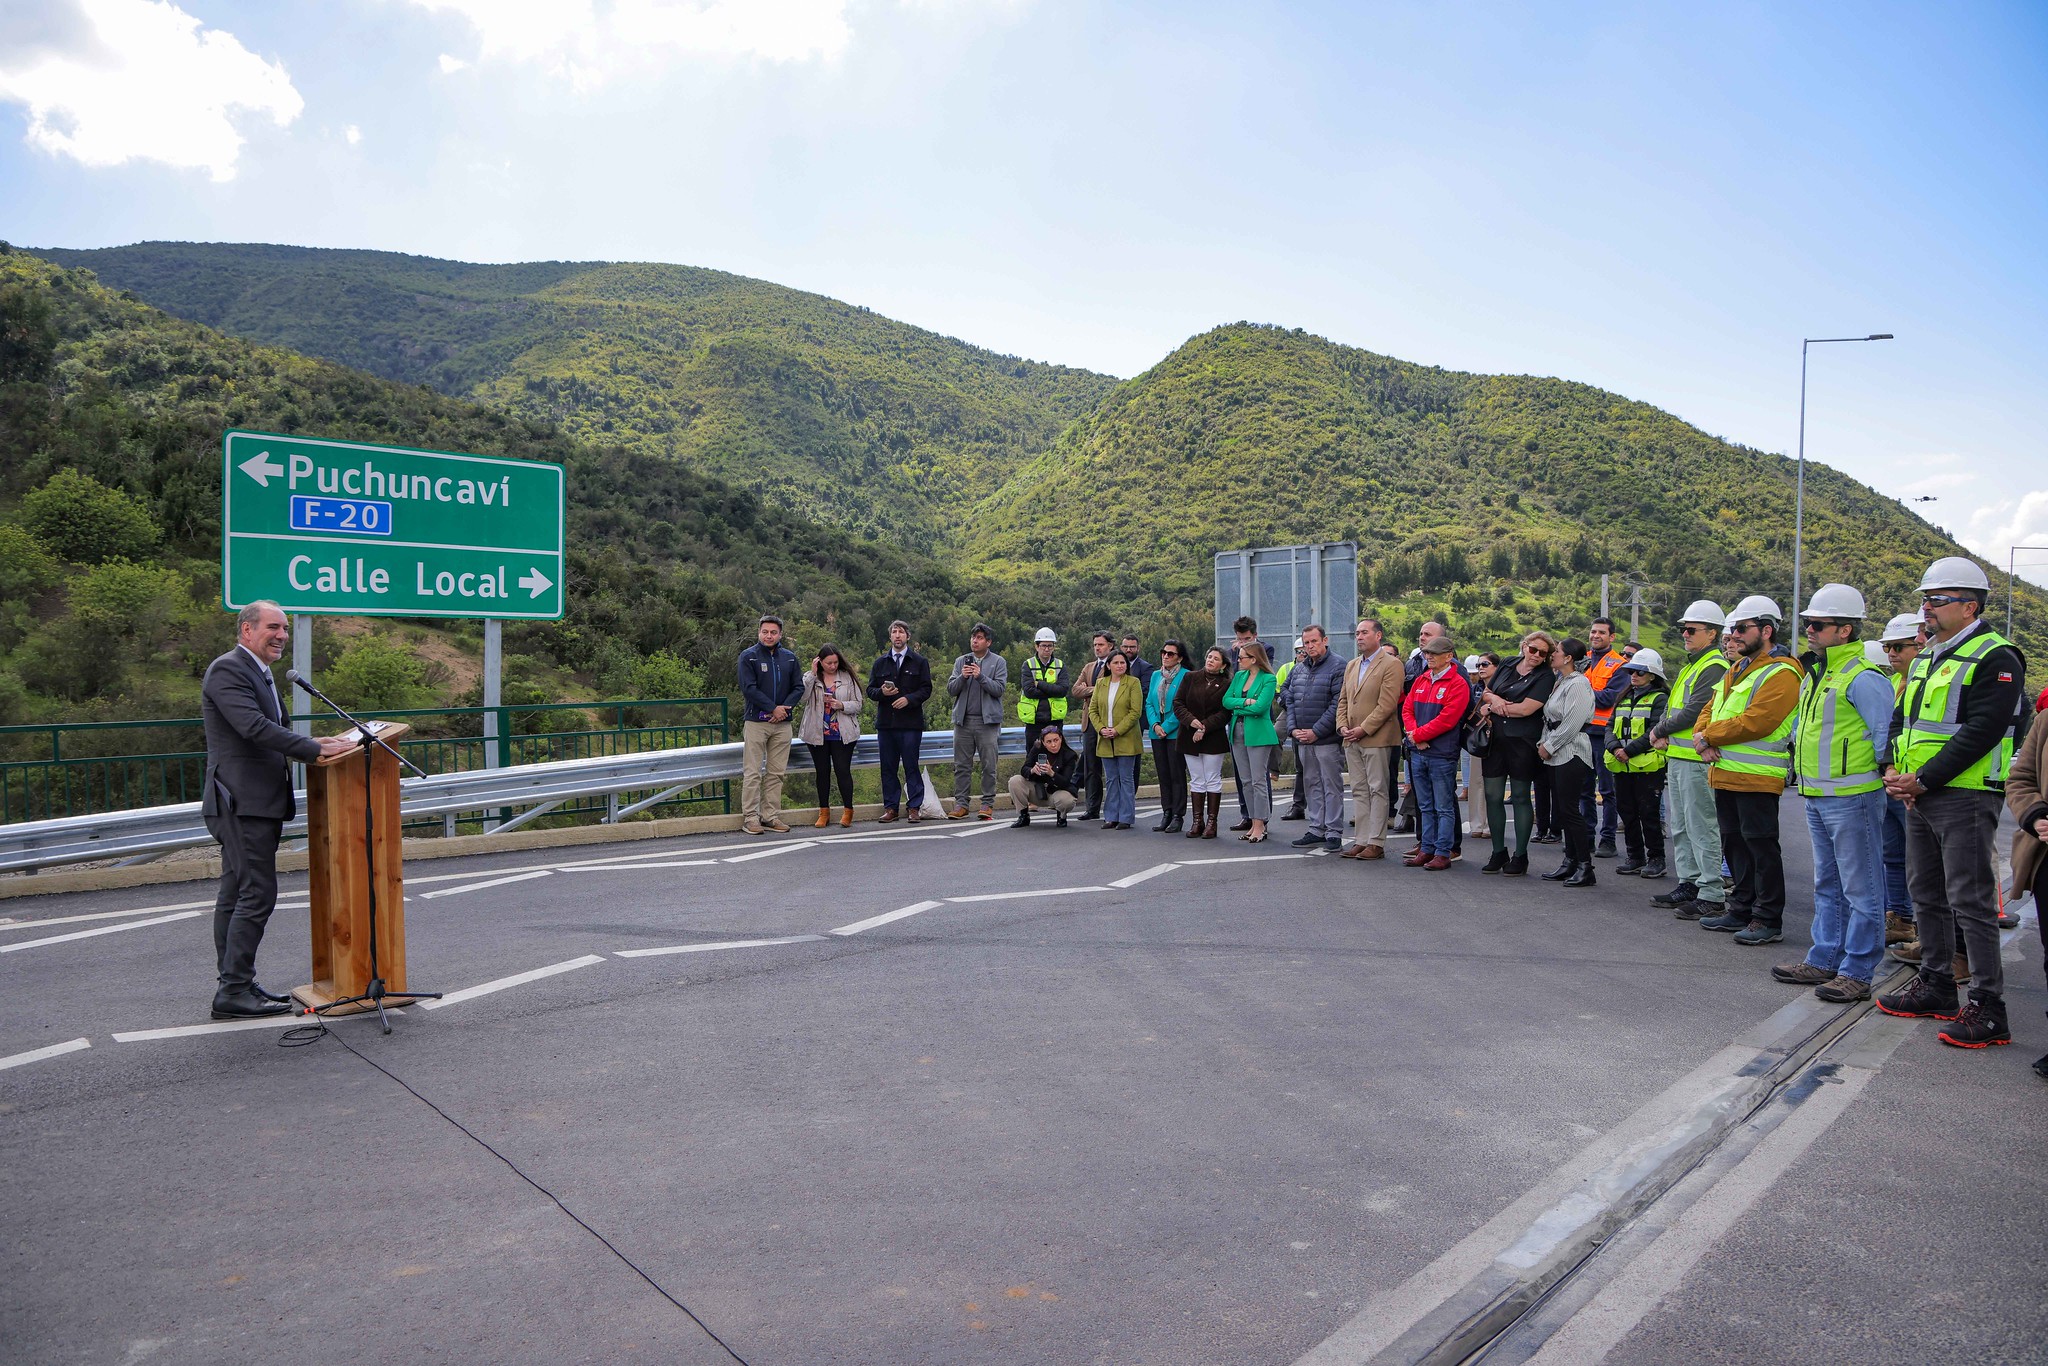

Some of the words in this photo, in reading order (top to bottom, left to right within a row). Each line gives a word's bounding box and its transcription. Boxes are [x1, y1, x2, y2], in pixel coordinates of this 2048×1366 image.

[288, 453, 510, 507] Puchuncaví
[304, 501, 380, 530] F-20
[287, 554, 391, 594] Calle
[416, 561, 509, 598] Local
